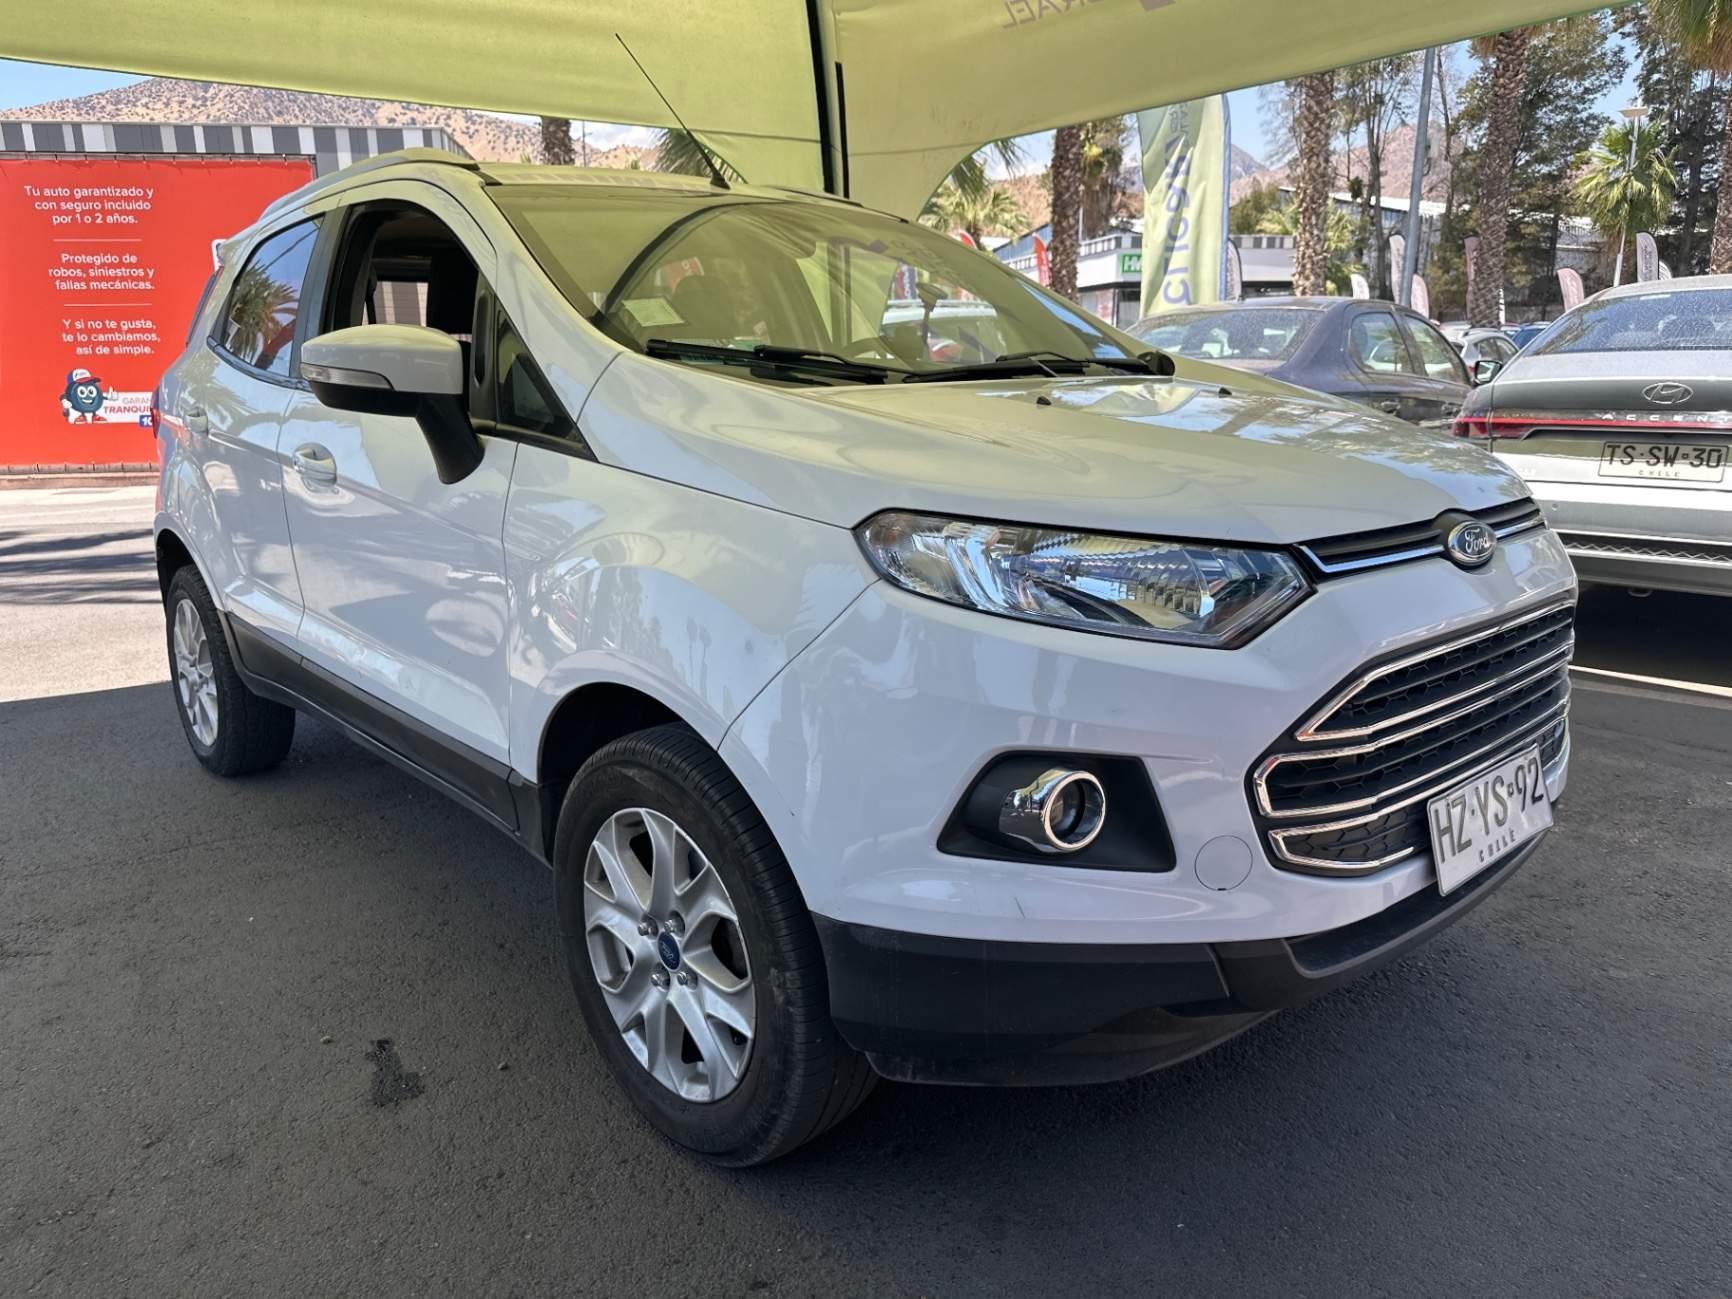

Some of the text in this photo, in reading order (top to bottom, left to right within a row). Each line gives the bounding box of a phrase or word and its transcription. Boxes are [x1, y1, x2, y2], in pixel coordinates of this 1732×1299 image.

[24, 185, 154, 199] Tu auto garantizado y
[34, 200, 151, 212] con seguro incluido
[52, 213, 138, 225] por 1 o 2 años.
[61, 253, 138, 265] Protegido de
[48, 266, 155, 278] robos, siniestros y
[55, 279, 155, 290] fallas mecánicas.
[62, 319, 156, 331] Y si no te gusta,
[62, 332, 161, 342] te lo cambiamos,
[76, 344, 155, 356] así de simple.
[1601, 413, 1729, 423] ACCENT
[1638, 469, 1680, 478] CHILE
[1465, 528, 1490, 553] Ford
[1478, 830, 1517, 863] CHILE
